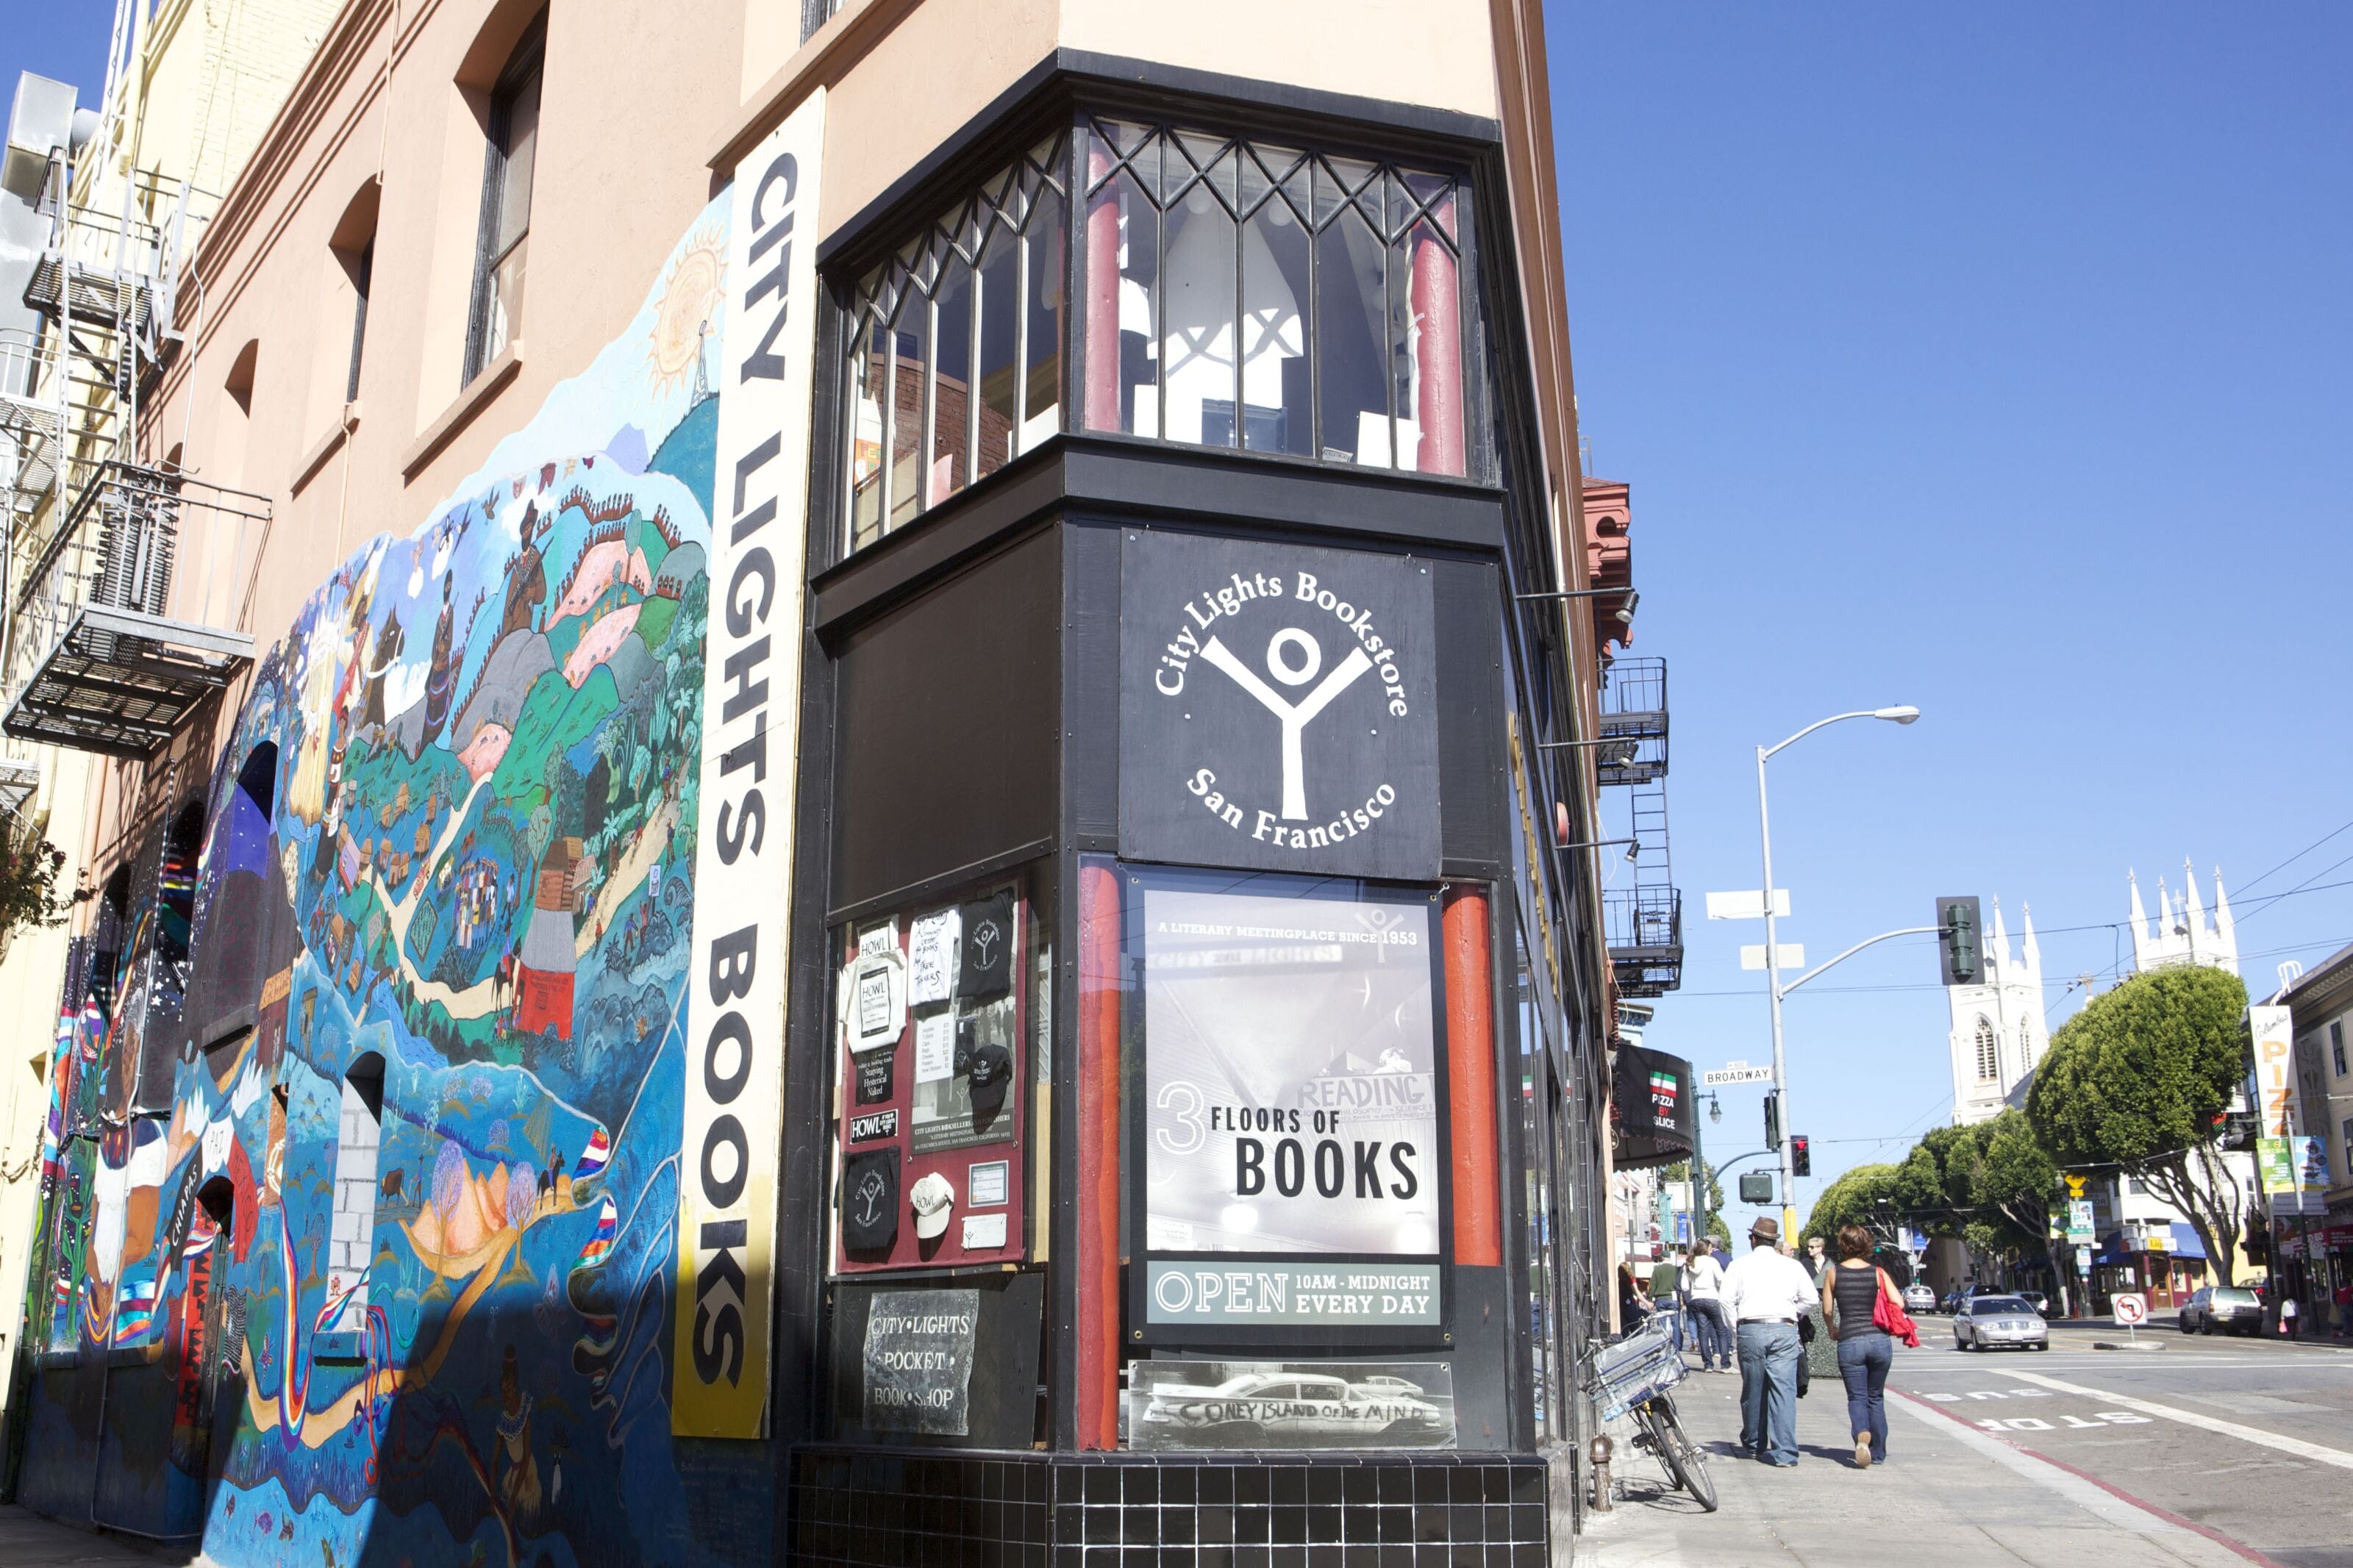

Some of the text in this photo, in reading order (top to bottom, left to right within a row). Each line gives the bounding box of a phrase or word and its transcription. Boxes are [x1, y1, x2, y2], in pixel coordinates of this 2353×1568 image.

[740, 152, 798, 385] CITY
[715, 430, 782, 865] LIGHTS
[1156, 571, 1408, 717] City Lights Bookstore
[1187, 768, 1396, 849] San Francisco
[1158, 922, 1418, 945] A LITERARY MEETINGPLACE SINCE 1953
[861, 937, 886, 956] HOWL
[863, 981, 885, 998] HOWL
[2255, 1014, 2288, 1039] Columbus
[864, 1074, 887, 1087] Hysterical
[865, 1066, 884, 1076] Starving
[1707, 1069, 1768, 1083] BROADWAY
[868, 1086, 883, 1097] Naked
[1297, 1076, 1425, 1108] READING
[2262, 1040, 2297, 1136] PIZZ
[1652, 1093, 1674, 1108] PIZZA
[1157, 1081, 1340, 1155] 3 FLOORS OF
[1659, 1106, 1670, 1117] BY
[852, 1117, 881, 1138] HOWL
[925, 1125, 941, 1134] LIGHTS
[1653, 1116, 1676, 1129] SLICE
[693, 923, 759, 1389] BOOKS
[1236, 1137, 1418, 1200] BOOKS
[172, 1164, 197, 1247] CHIAPAS
[915, 1195, 936, 1208] HOWL
[2149, 1238, 2174, 1249] Liquor
[1155, 1271, 1288, 1313] OPEN
[1296, 1275, 1337, 1290] 10AM
[1349, 1275, 1430, 1290] MIDNIGHT
[1296, 1295, 1429, 1314] EVERY DAY
[885, 1352, 946, 1370] POCKET
[1180, 1403, 1257, 1421] CONEY
[1262, 1403, 1318, 1420] ISLAND
[1365, 1405, 1424, 1420] MIND
